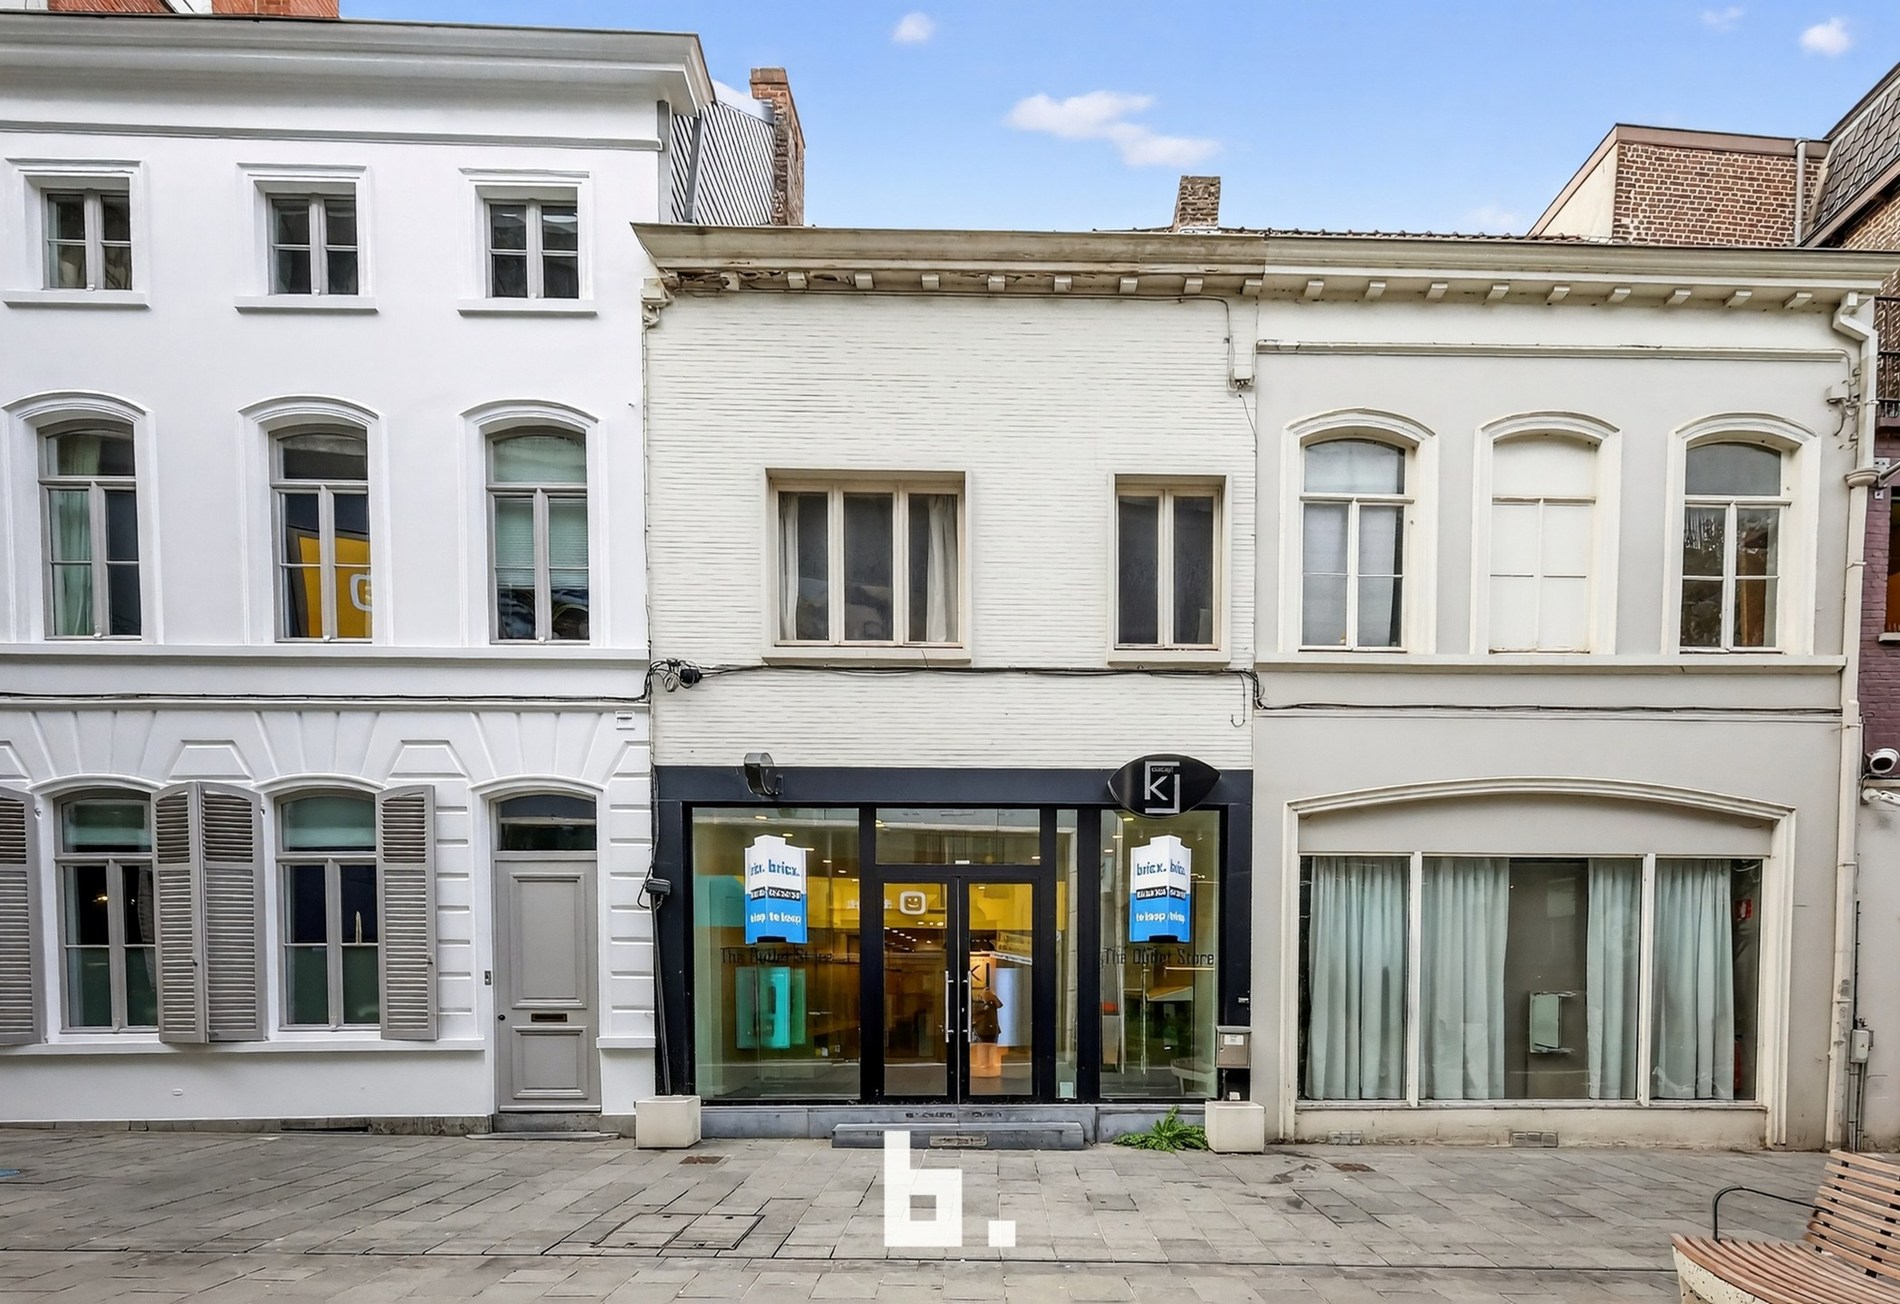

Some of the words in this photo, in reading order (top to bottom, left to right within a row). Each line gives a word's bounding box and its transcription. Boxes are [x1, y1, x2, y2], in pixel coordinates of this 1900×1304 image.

[720, 947, 745, 964] The
[1103, 947, 1126, 964] The
[1177, 947, 1214, 965] Store
